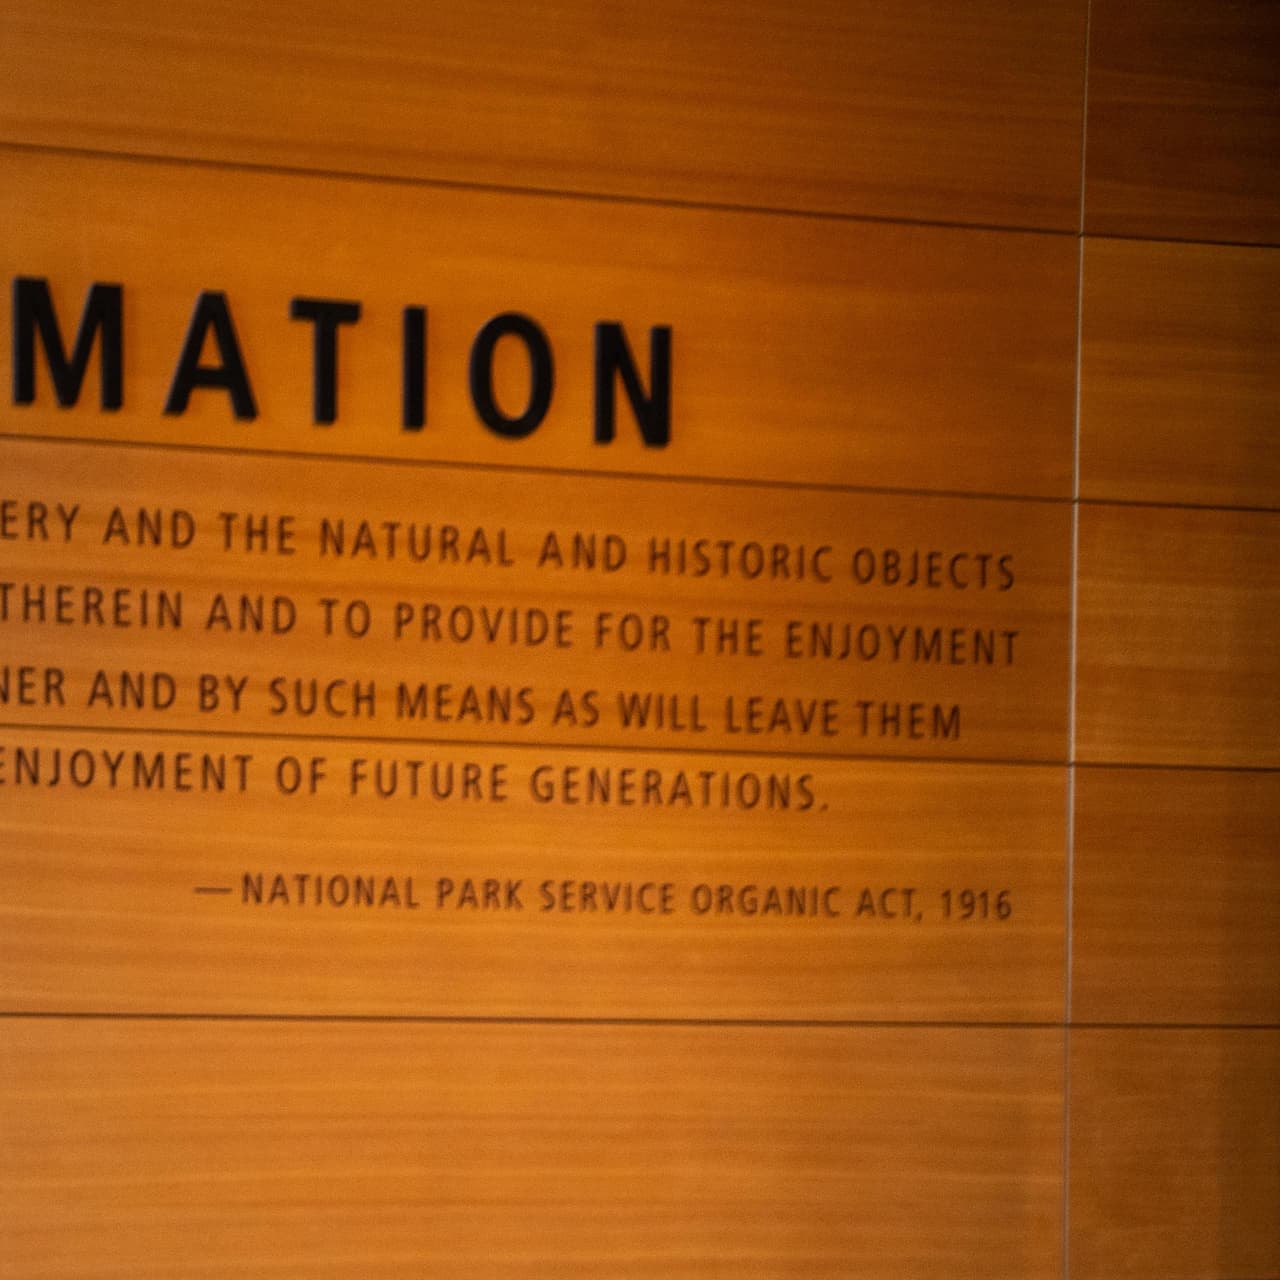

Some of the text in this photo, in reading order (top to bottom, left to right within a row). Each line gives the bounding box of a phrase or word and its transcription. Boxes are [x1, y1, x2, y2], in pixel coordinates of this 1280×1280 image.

[102, 507, 196, 549] AND
[219, 511, 296, 555] THE
[320, 518, 514, 568] NATURAL
[540, 531, 627, 573] AND
[648, 537, 833, 582] HISTORIC
[852, 547, 1016, 591] OBJECTS
[206, 593, 297, 635] AND
[320, 598, 372, 639] TO
[394, 602, 574, 648] PROVIDE
[595, 612, 671, 651] FOR
[693, 616, 764, 656] THE
[785, 620, 1020, 665] ENJOYMENT
[88, 669, 178, 711] AND
[198, 673, 249, 713] BY
[269, 676, 377, 719] SUCH
[396, 682, 535, 727] MEANS
[552, 689, 600, 728] AS
[618, 691, 707, 733] WILL
[724, 695, 840, 738] LEAVE
[856, 700, 963, 741] THEM
[276, 755, 328, 795] OF
[350, 758, 508, 800] FUTURE
[530, 764, 830, 812] GENERATIONS.
[435, 877, 524, 913] PARK
[539, 880, 677, 916] SERVICE
[690, 883, 842, 919] ORGANIC
[854, 887, 924, 922] ACT,
[941, 889, 1014, 922] 1916
